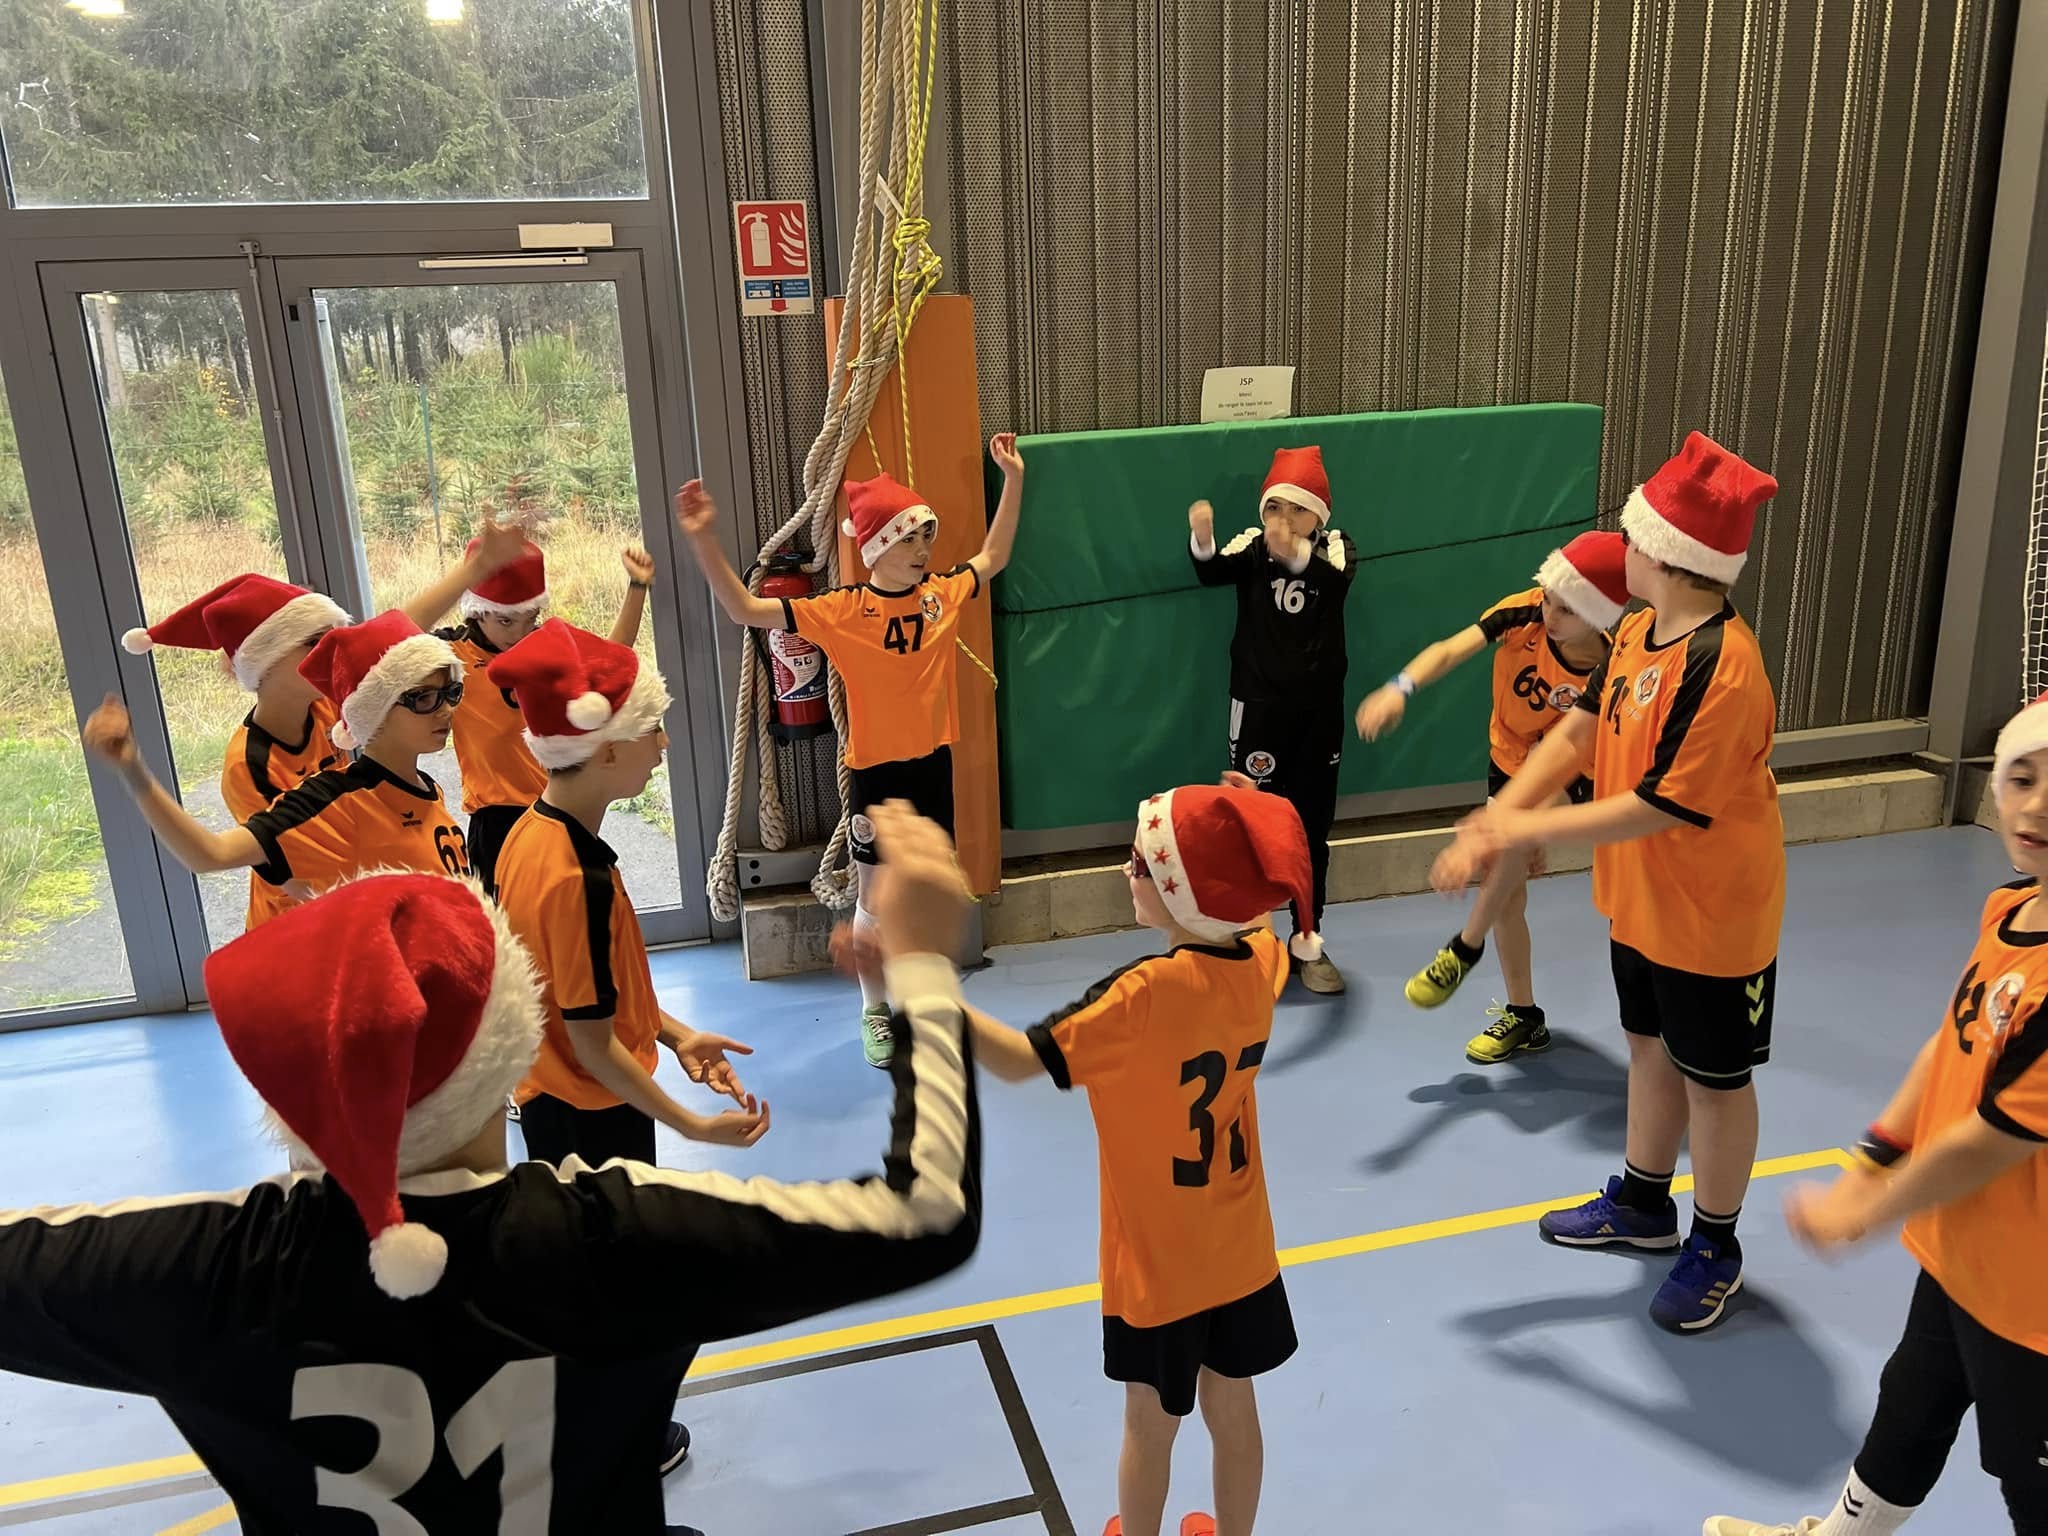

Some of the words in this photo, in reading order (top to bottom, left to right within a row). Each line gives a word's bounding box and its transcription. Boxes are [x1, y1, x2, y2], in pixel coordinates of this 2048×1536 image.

[1271, 578, 1305, 613] 16
[884, 612, 924, 654] 47
[1513, 665, 1552, 711] 65
[290, 1355, 557, 1536] 31
